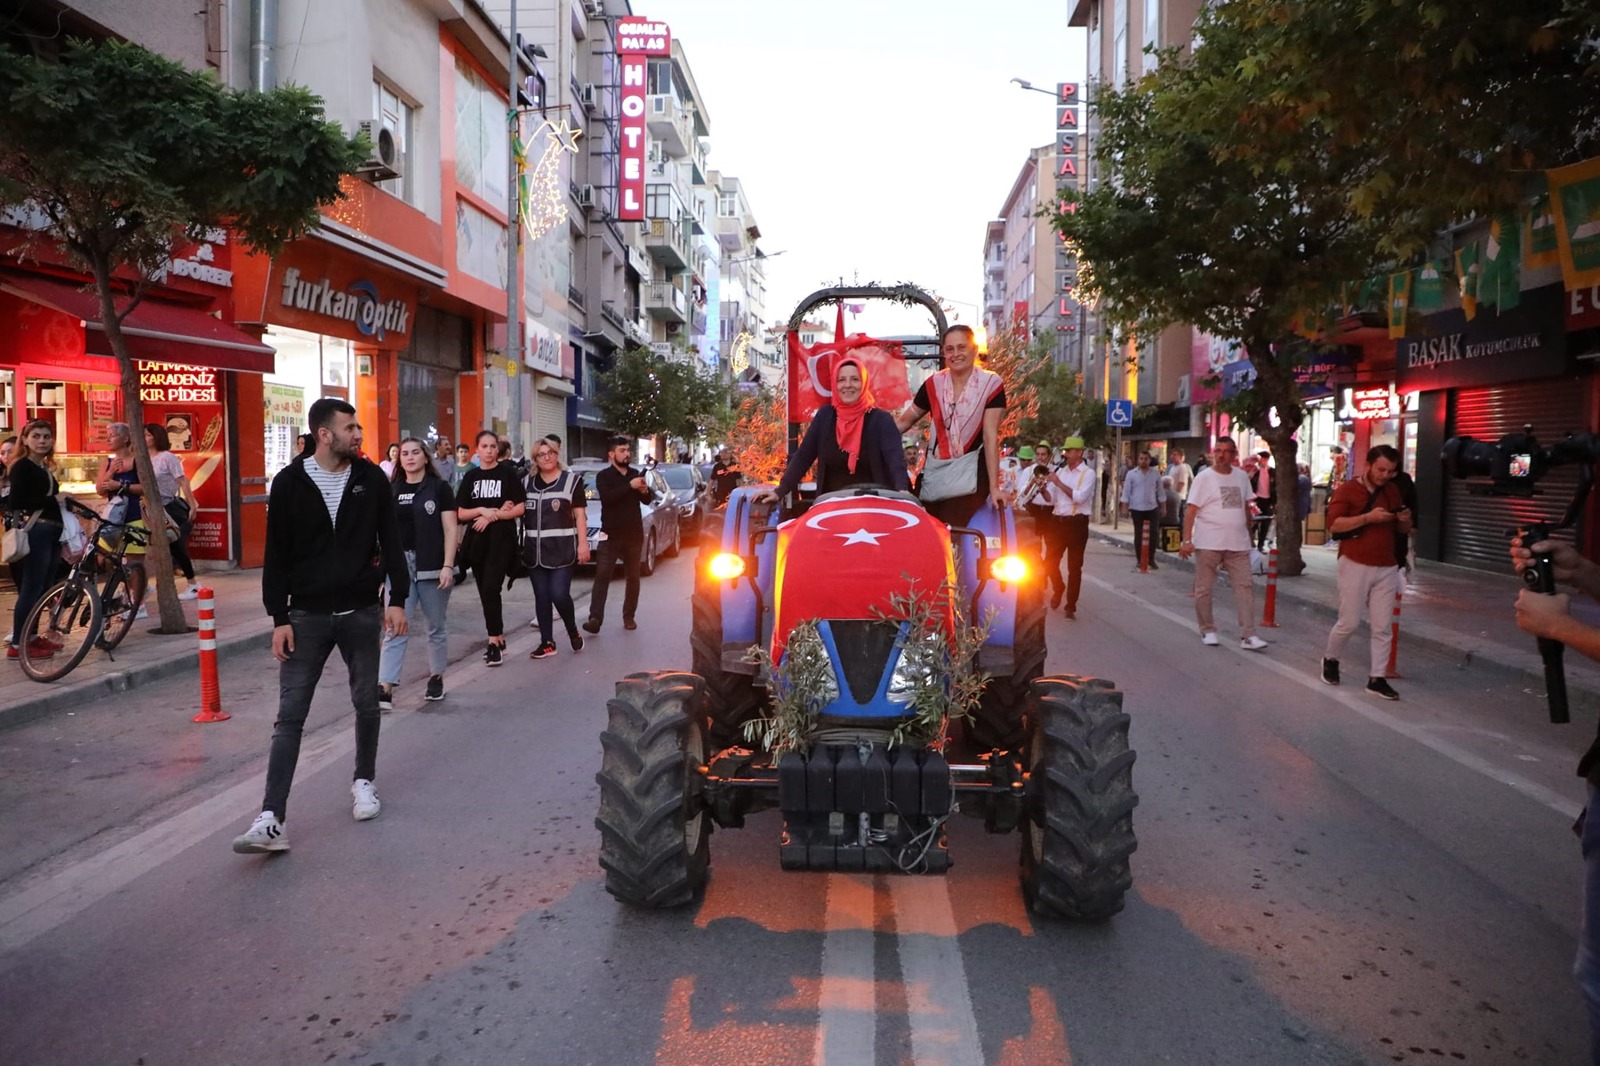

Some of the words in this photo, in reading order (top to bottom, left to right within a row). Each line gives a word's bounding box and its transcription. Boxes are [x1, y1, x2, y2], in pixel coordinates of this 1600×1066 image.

[622, 38, 665, 50] PALAS
[622, 64, 645, 211] HOTEL
[1060, 84, 1077, 176] PAŞA
[281, 267, 358, 321] furkan
[362, 299, 409, 336] optik
[1408, 333, 1463, 369] BAŞAK
[140, 371, 215, 386] KARADENİZ
[140, 388, 165, 401] KIR
[168, 386, 217, 402] PİDESİ
[480, 479, 502, 498] NBA
